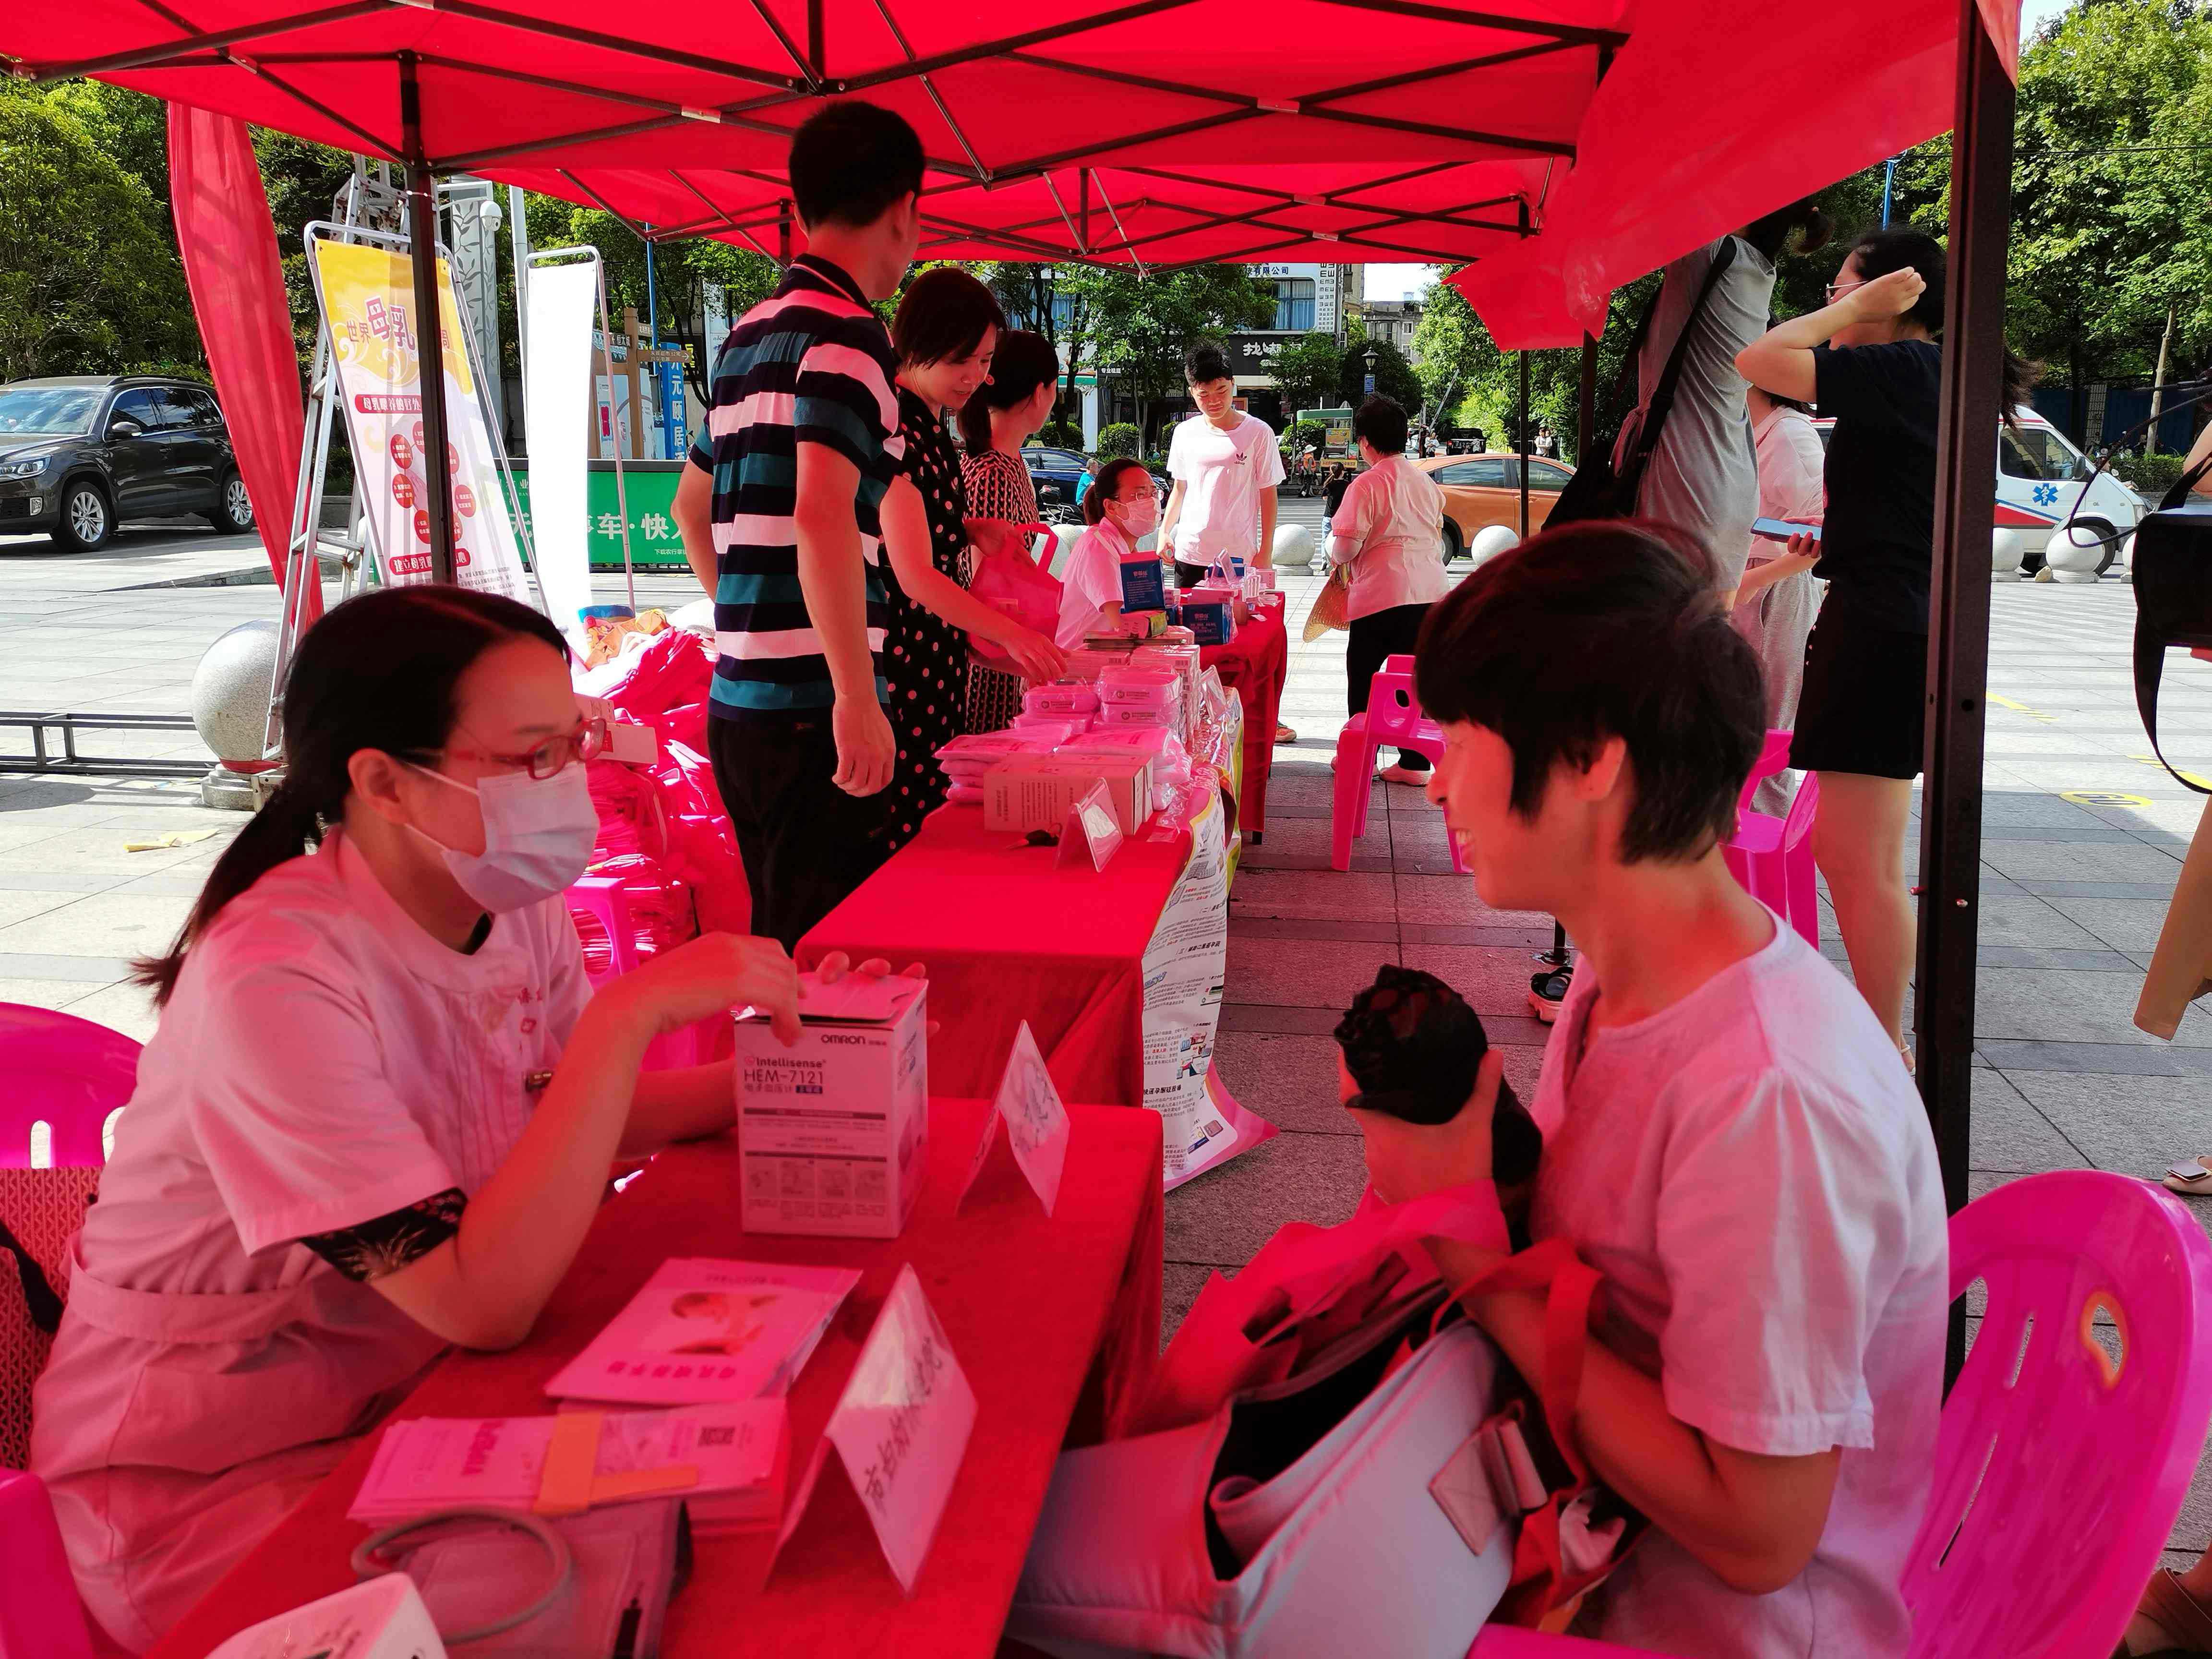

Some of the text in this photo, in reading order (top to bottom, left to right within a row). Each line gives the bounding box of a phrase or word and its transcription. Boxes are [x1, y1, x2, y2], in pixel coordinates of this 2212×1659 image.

[821, 1034, 866, 1045] OMRON
[756, 1057, 822, 1068] Intellisense
[745, 1069, 823, 1083] HEM-7121
